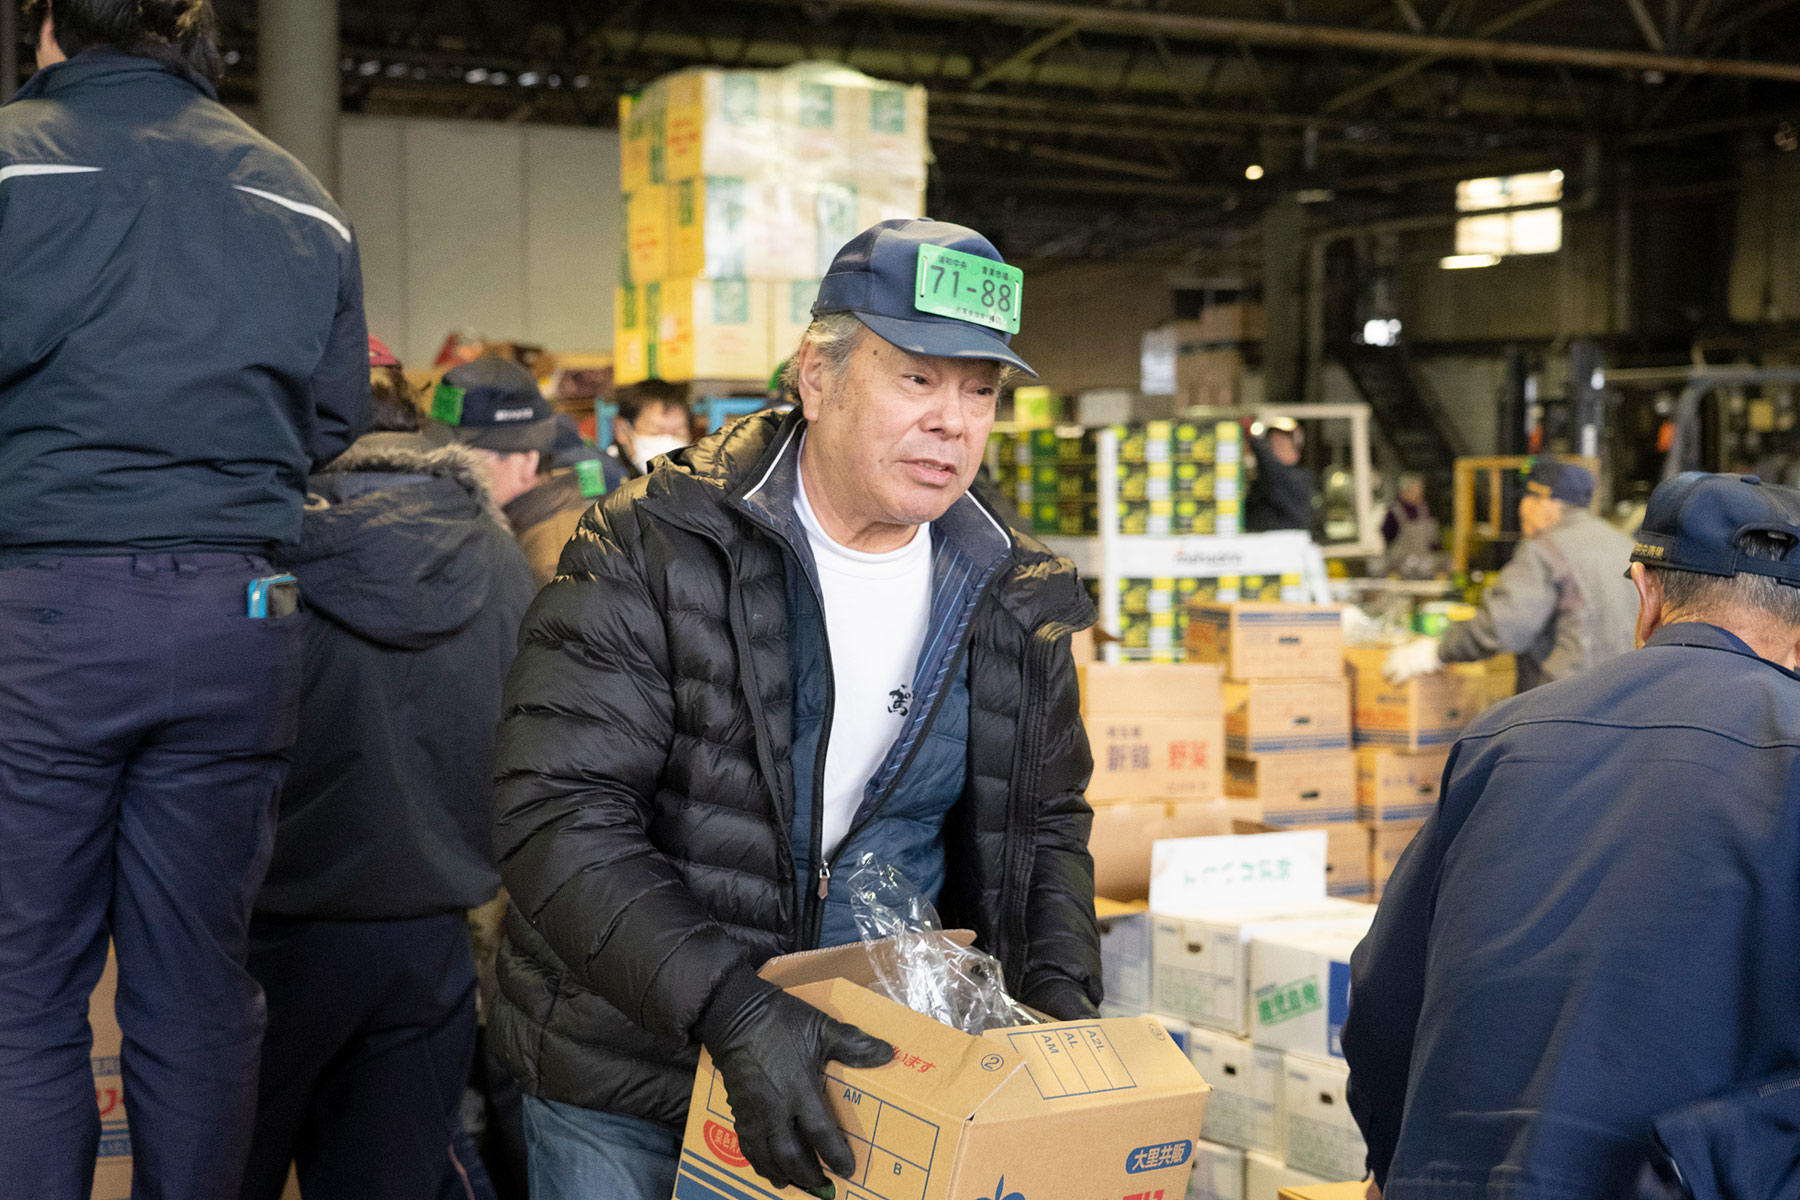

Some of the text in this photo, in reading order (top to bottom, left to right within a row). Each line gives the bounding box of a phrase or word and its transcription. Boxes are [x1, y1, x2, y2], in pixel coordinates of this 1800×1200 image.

[930, 264, 1012, 313] 71-88
[1041, 1034, 1060, 1055] AM
[1063, 1031, 1080, 1049] AL
[843, 1088, 862, 1105] AM
[1132, 1142, 1187, 1171] 大里共販
[893, 1161, 903, 1176] B
